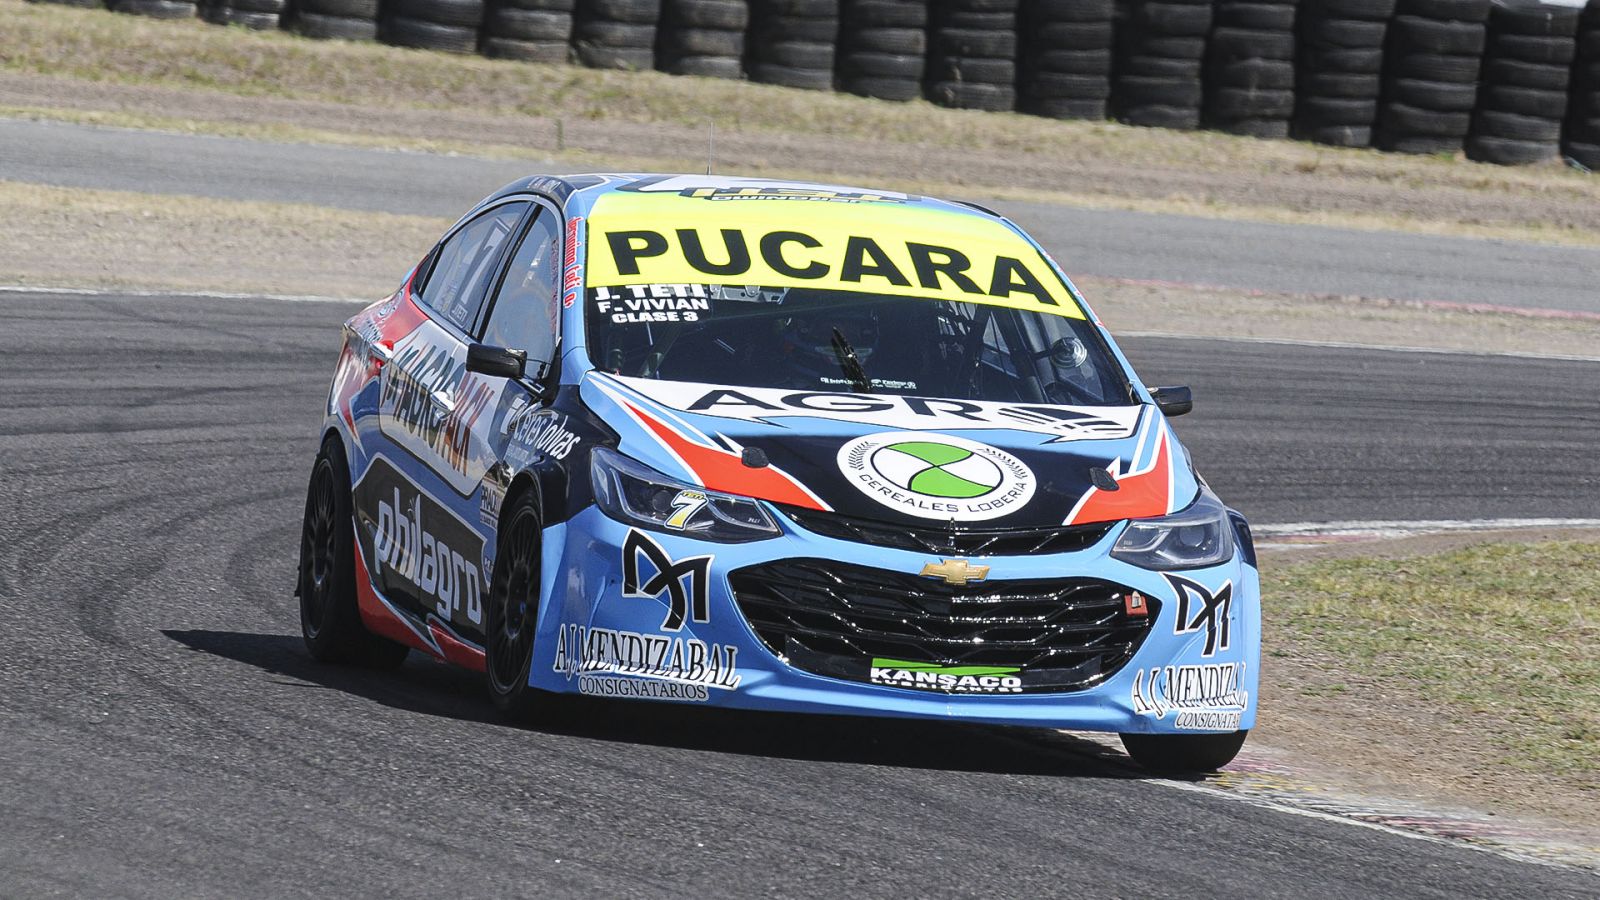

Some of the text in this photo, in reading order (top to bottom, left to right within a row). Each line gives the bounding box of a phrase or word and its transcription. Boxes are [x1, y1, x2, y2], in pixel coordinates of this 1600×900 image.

[604, 227, 1061, 307] PUCARA
[625, 283, 707, 298] TETI
[611, 311, 699, 324] CLASE 3
[624, 299, 710, 311] VIVIAN
[858, 473, 1028, 514] CEREALES LOBERIA
[664, 491, 708, 529] 7
[373, 486, 482, 625] philagro
[579, 675, 707, 700] CONSIGNATARIOS
[870, 667, 1022, 688] KANSACO
